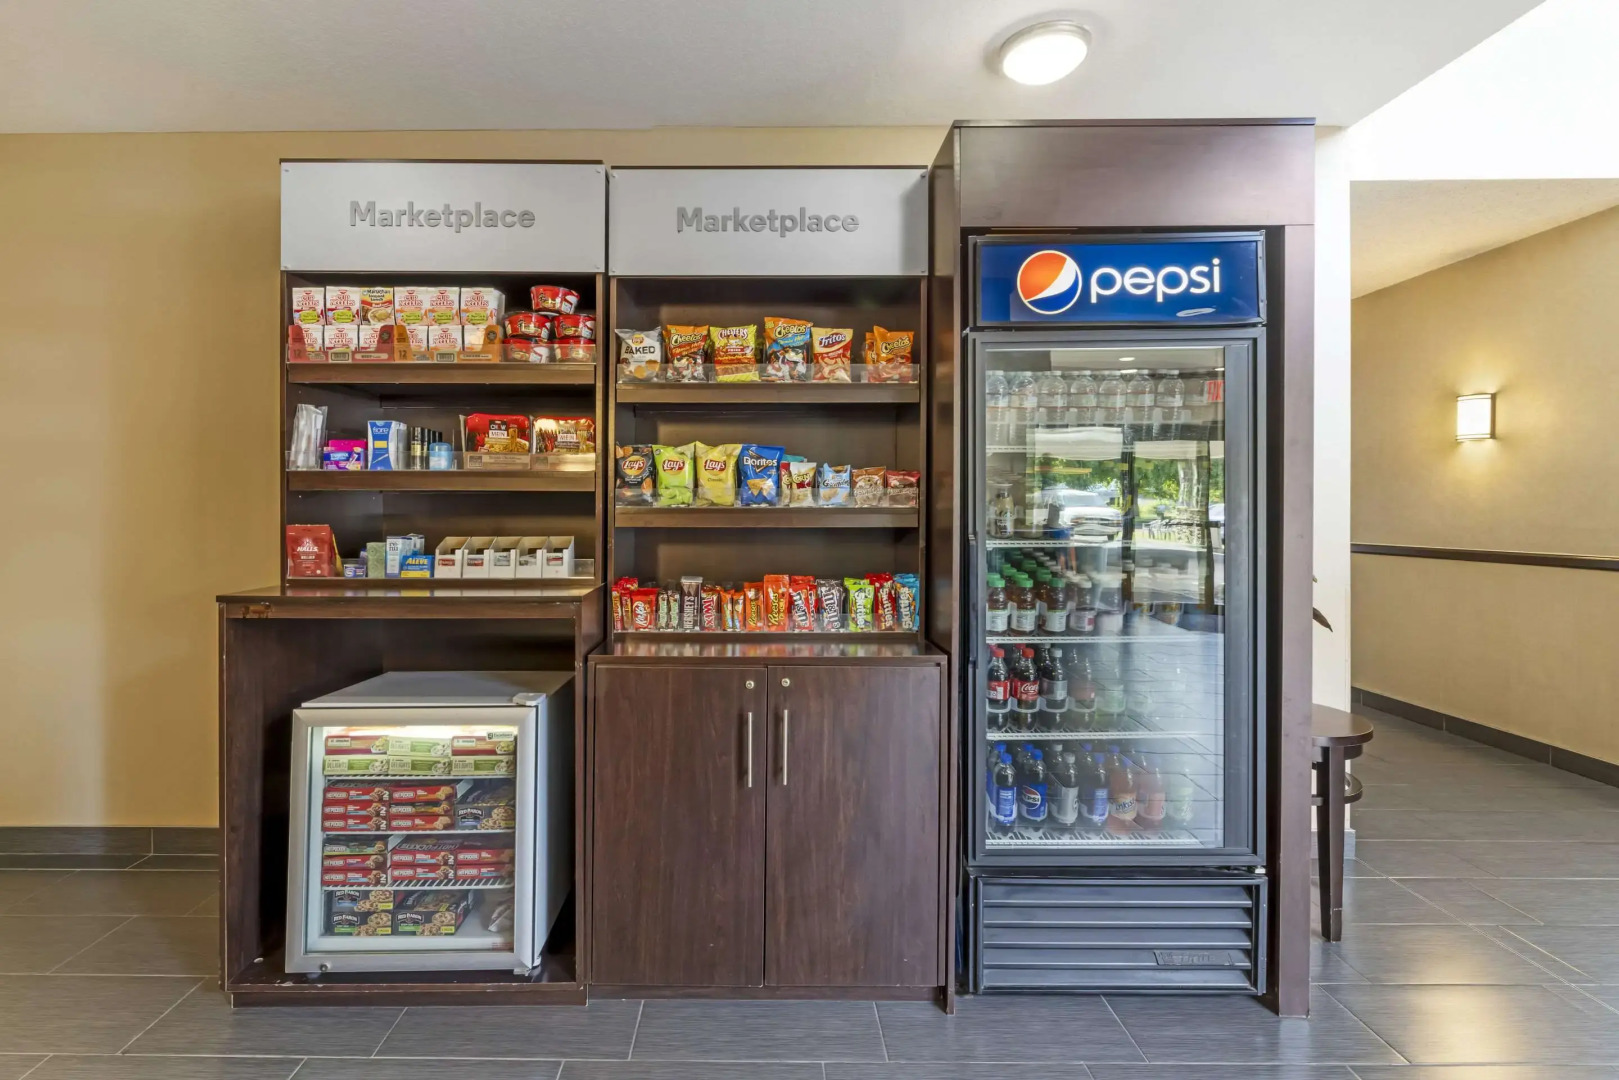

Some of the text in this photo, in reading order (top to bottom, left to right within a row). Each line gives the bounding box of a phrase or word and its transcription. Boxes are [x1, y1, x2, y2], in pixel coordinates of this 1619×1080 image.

[350, 201, 535, 233] Marketplace
[677, 207, 860, 237] Marketplace
[1090, 258, 1221, 303] pepsi
[774, 325, 806, 338] Cheetos
[818, 333, 846, 347] Fritos
[625, 346, 656, 354] BAKED
[881, 336, 911, 353] Cheetos
[744, 456, 778, 466] Doritos
[684, 595, 694, 629] HERSHEY'S
